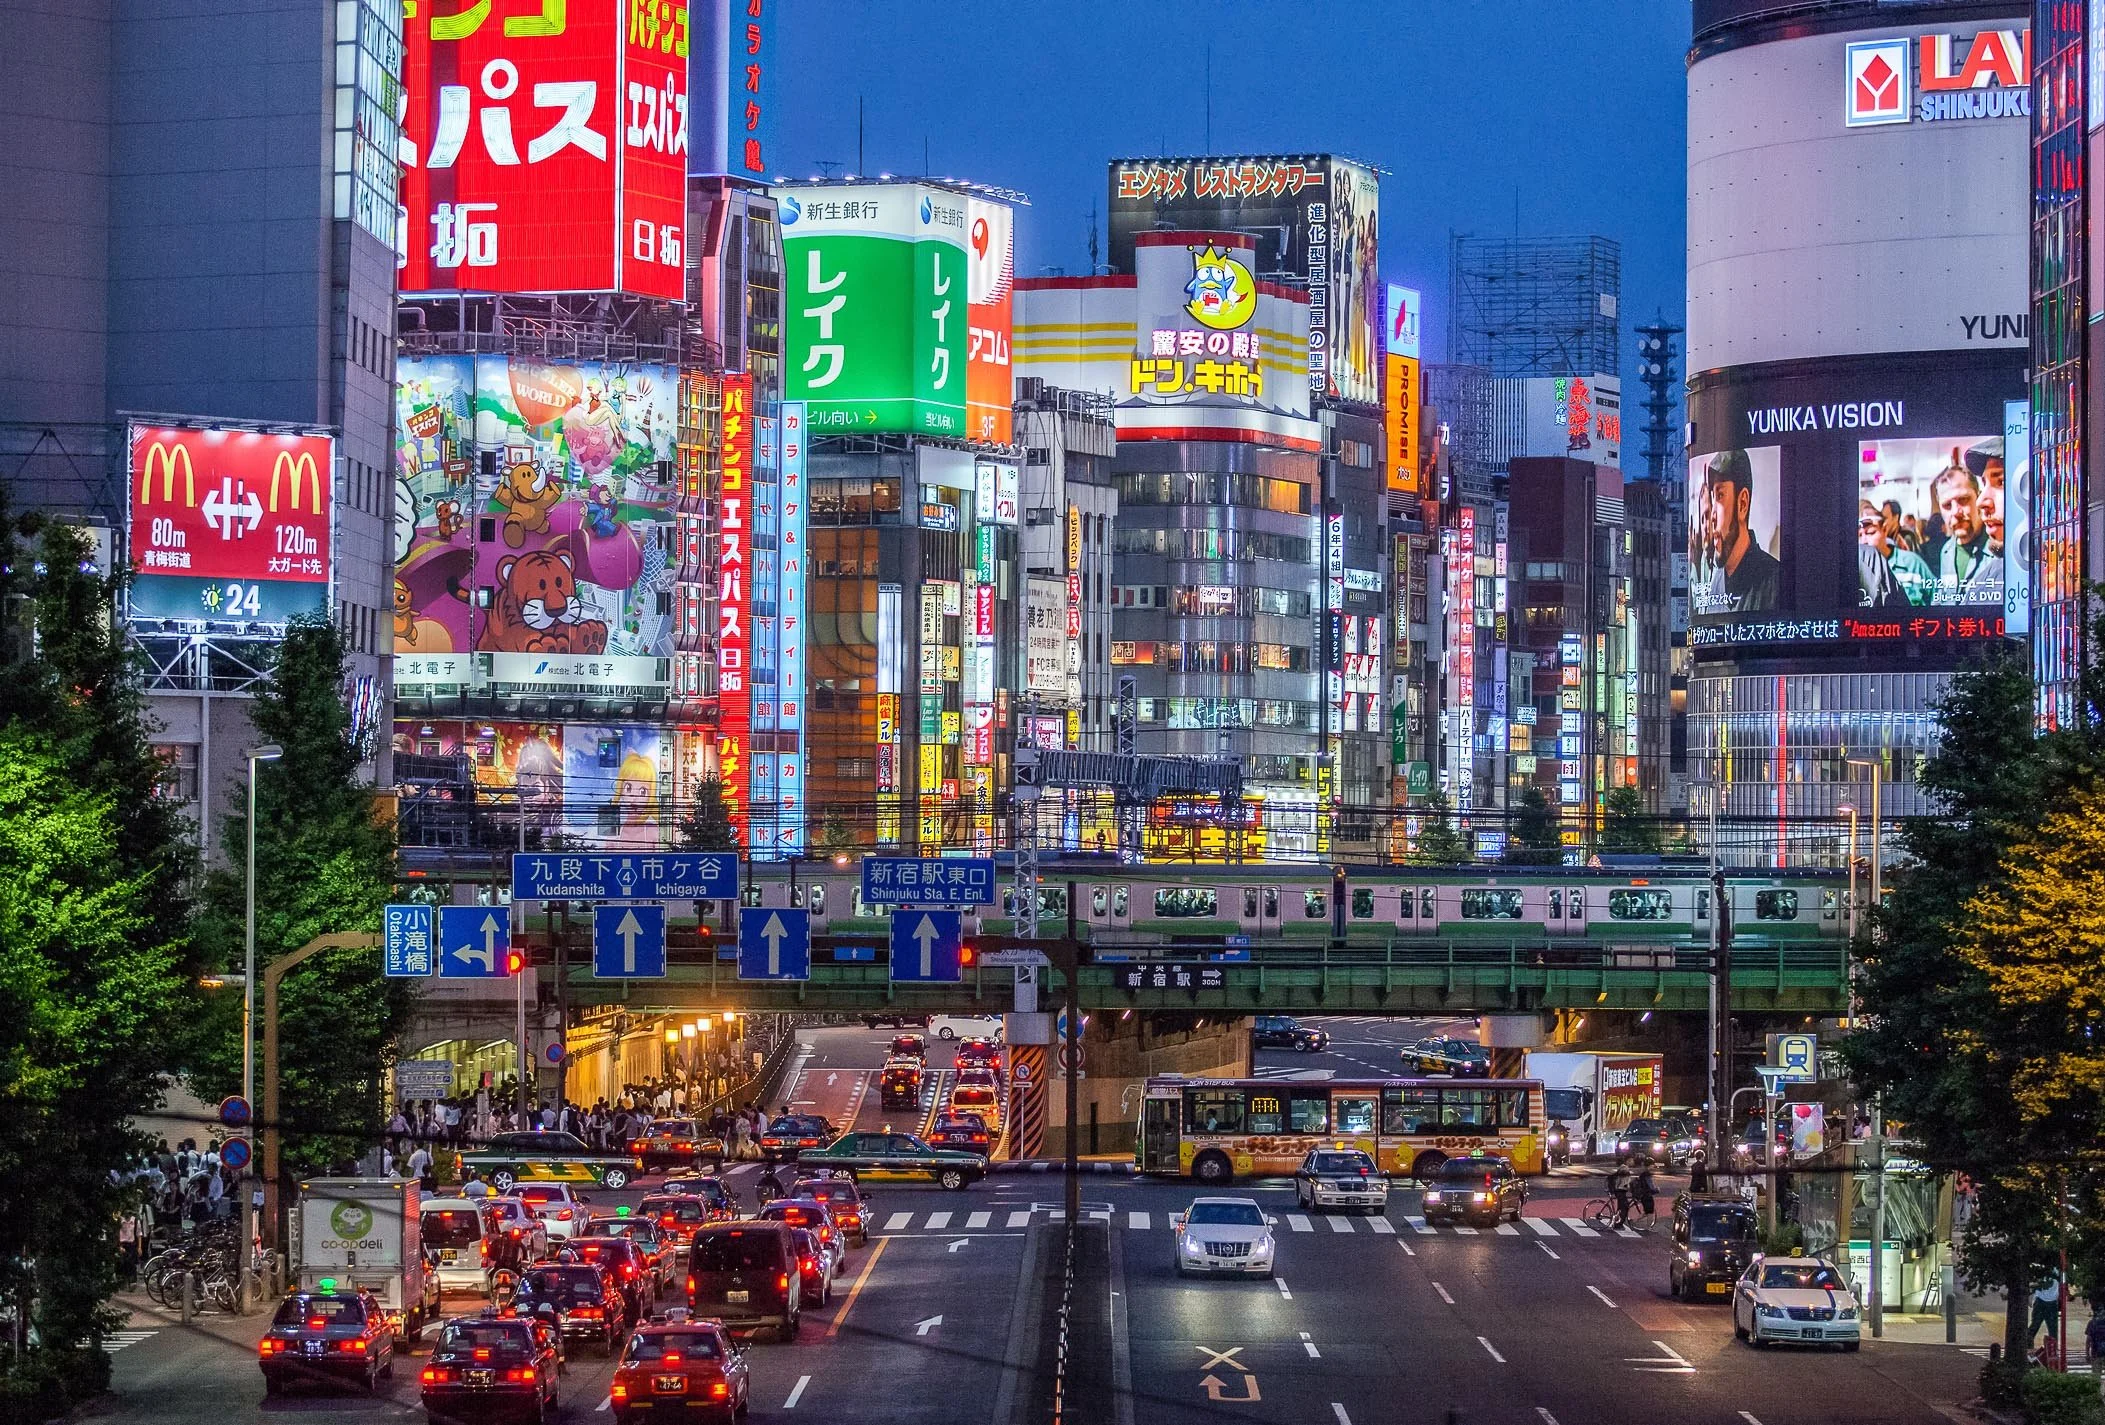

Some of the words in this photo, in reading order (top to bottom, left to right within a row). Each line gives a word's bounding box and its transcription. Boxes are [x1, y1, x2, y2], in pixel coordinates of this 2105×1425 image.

[1920, 30, 2031, 91] LA
[627, 71, 690, 158] エスパス
[1118, 166, 1188, 200] エンタメ
[1193, 164, 1326, 199] レストランタワー
[807, 200, 879, 221] 新生銀行
[933, 205, 965, 229] 新生銀行
[802, 249, 848, 390] レイク
[931, 252, 951, 390] レイク
[968, 325, 1010, 367] アコム
[516, 382, 567, 409] WORLD
[1400, 363, 1410, 461] PROMISE
[1747, 405, 1818, 435] YUNIKA
[1821, 400, 1904, 430] VISION
[723, 388, 745, 491] パチンコ
[151, 517, 186, 548] 80m
[275, 524, 317, 555] 120m
[144, 550, 192, 569] 青梅街道
[268, 558, 323, 575] 大ガード先
[720, 498, 742, 638] エスパス
[226, 583, 262, 617] 24
[1979, 591, 2002, 601] DVD
[980, 598, 991, 634] アイフル
[409, 661, 456, 676] 北電子
[573, 662, 614, 677] 北電子
[720, 648, 742, 692] 日拓
[979, 728, 989, 755] アコム
[1394, 718, 1404, 744] レイク
[1411, 769, 1428, 788] レイク
[530, 858, 613, 882] 九段下
[536, 883, 616, 895] Kudanshita
[655, 884, 707, 898] Ichigaya
[870, 888, 920, 902] Shinjuku
[924, 888, 946, 901] Sta.
[964, 888, 986, 902] Ent.
[389, 911, 403, 971] Otakibashi
[404, 909, 428, 972] 小滝橋
[1127, 972, 1191, 987] 新宿駅
